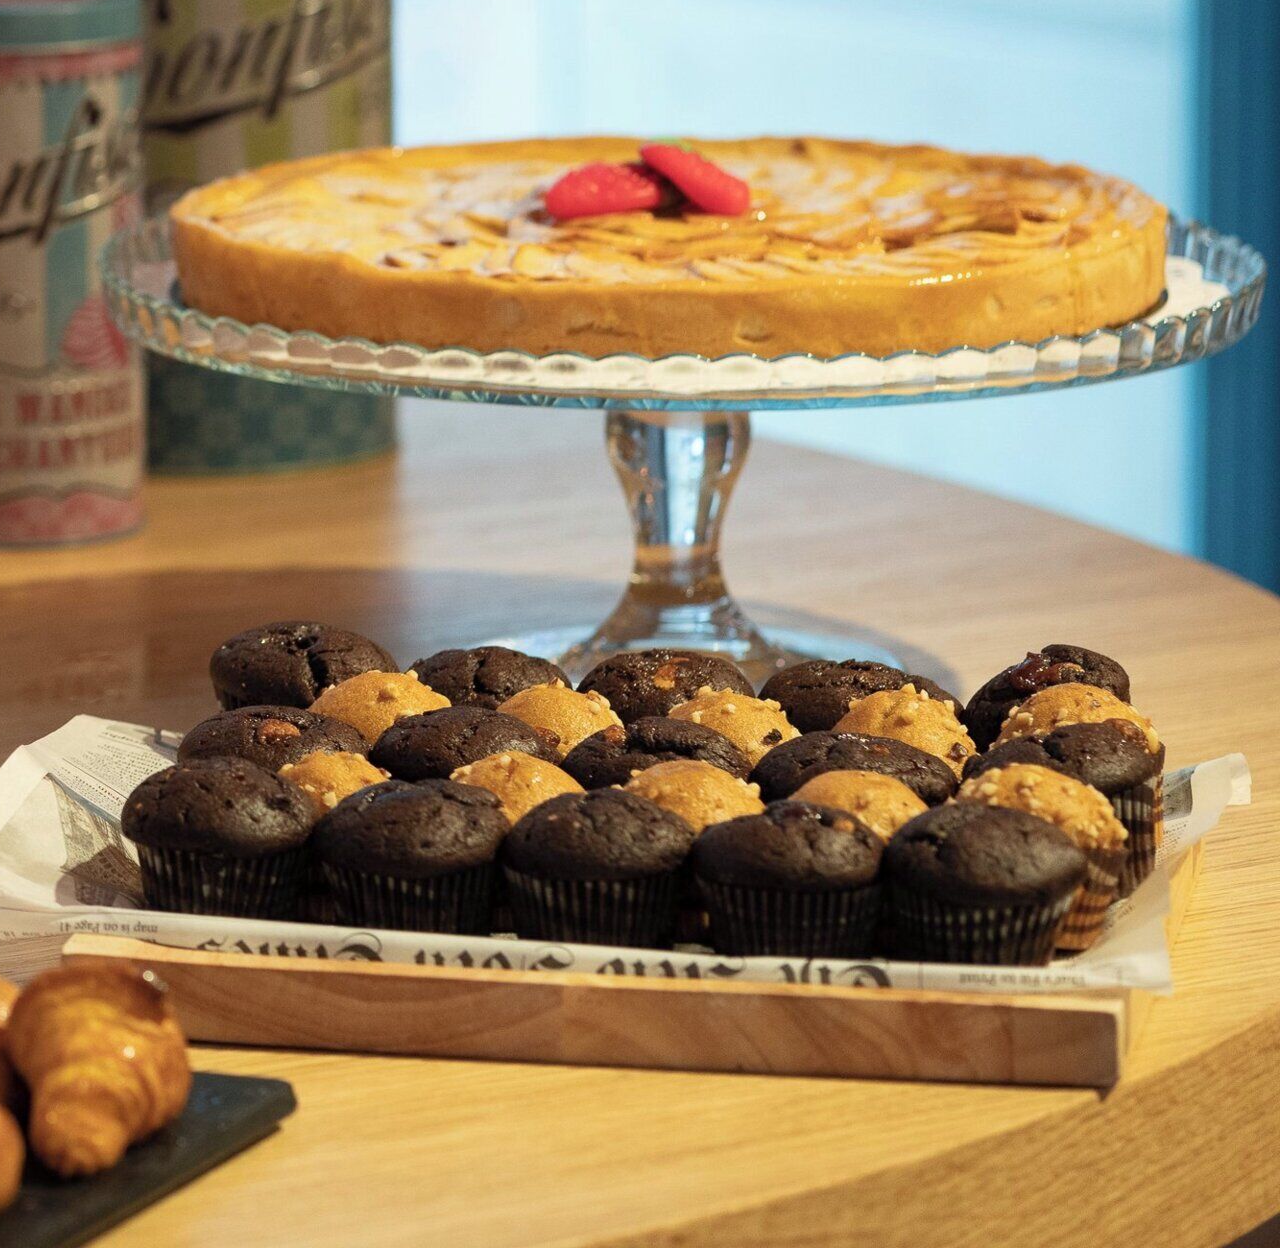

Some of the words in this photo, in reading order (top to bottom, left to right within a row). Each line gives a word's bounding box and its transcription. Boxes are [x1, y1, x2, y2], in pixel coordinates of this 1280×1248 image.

[74, 920, 100, 934] Page
[103, 922, 119, 932] on
[120, 924, 130, 934] is
[133, 921, 158, 934] map
